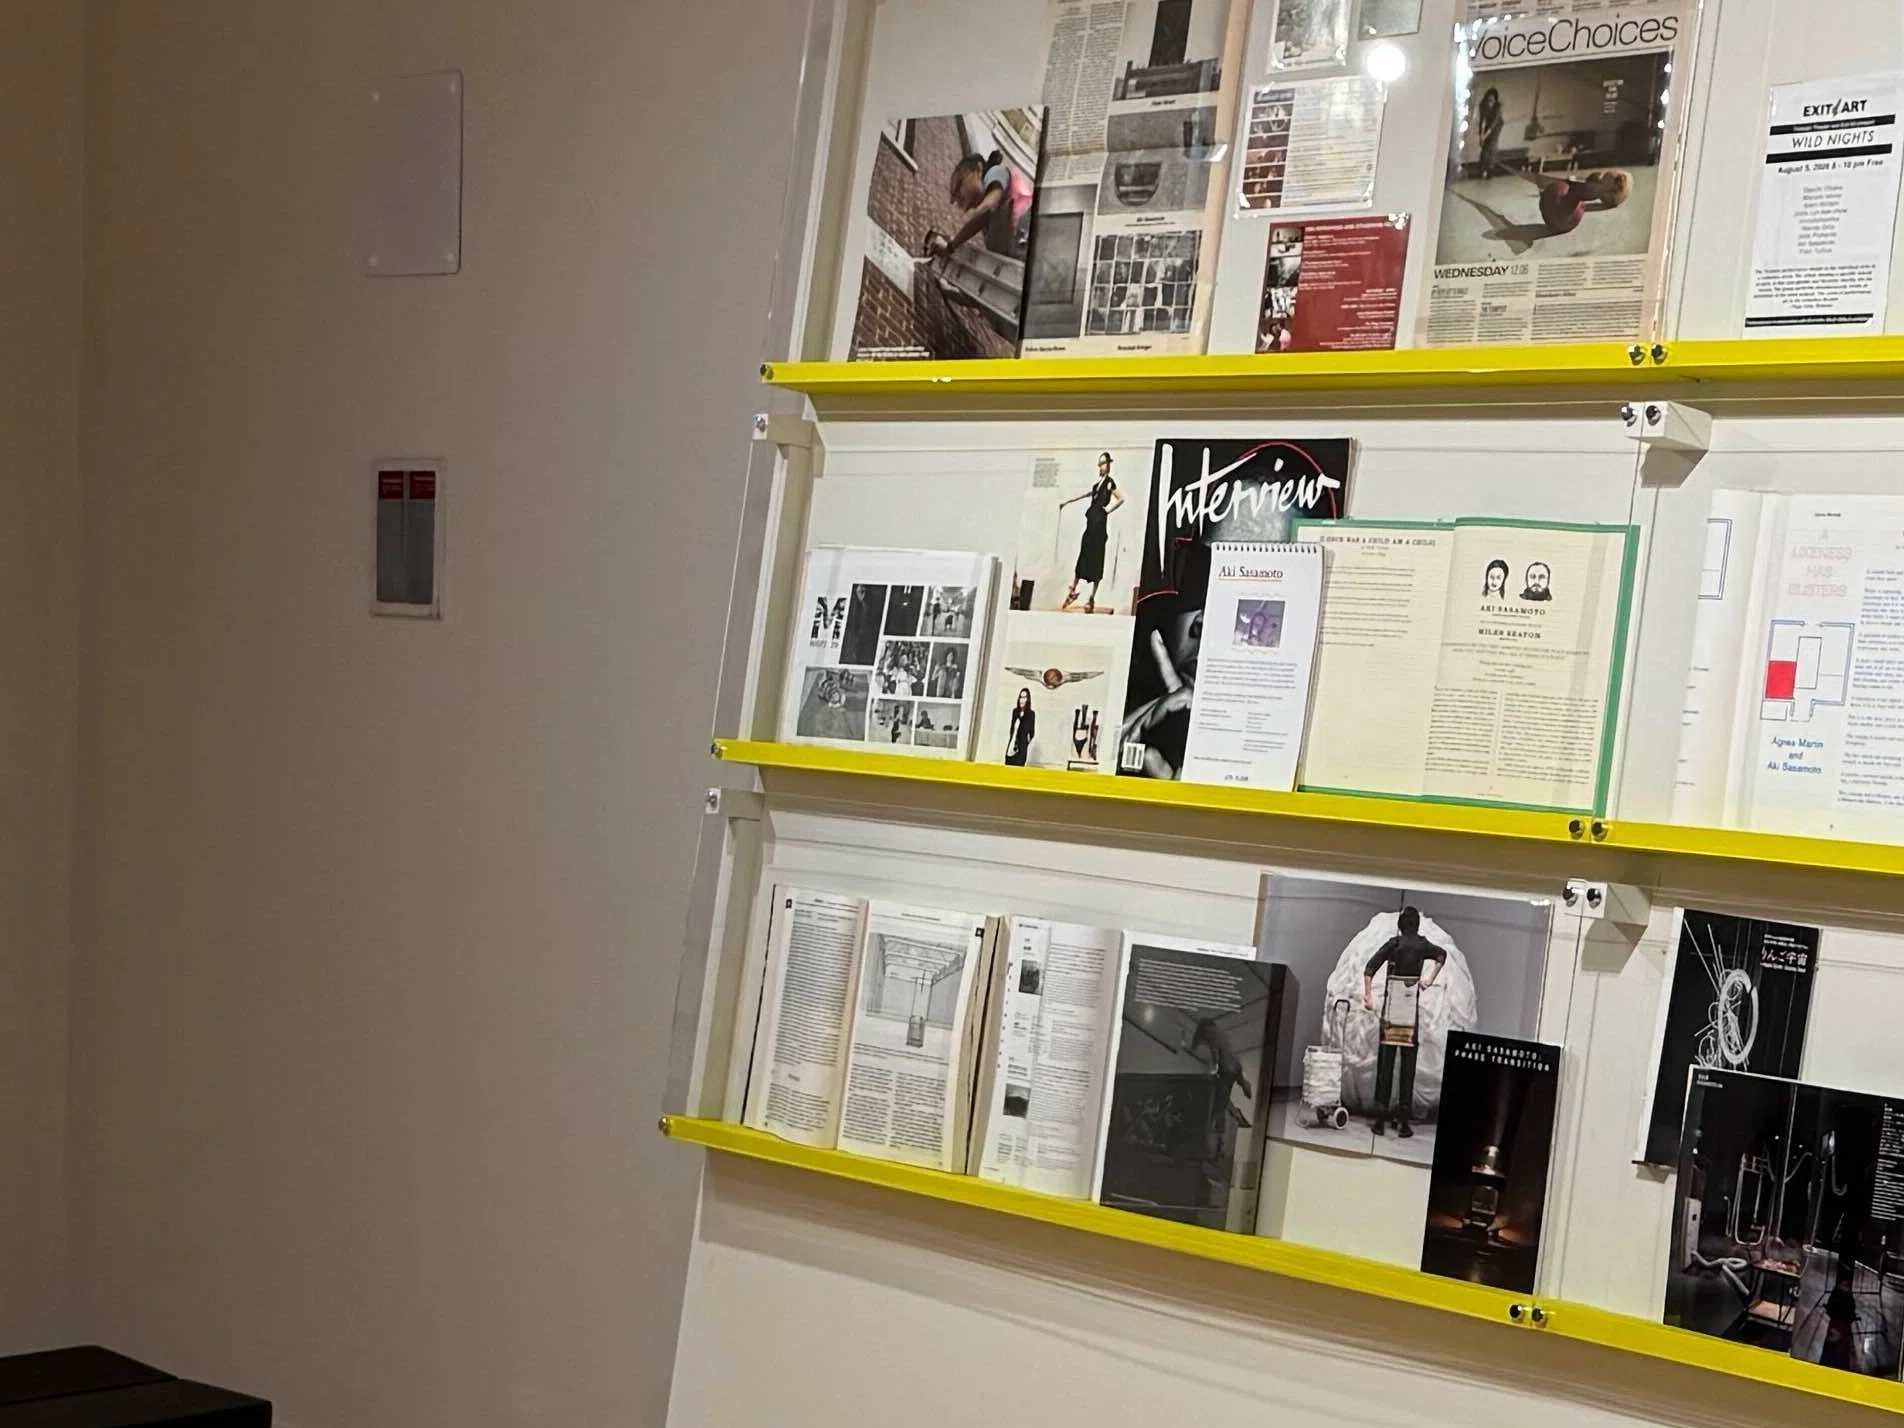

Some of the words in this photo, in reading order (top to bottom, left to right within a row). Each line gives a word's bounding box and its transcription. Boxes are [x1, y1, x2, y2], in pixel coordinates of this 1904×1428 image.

[1792, 135, 1823, 149] WILD
[1827, 130, 1875, 146] NIGHTS
[1778, 166, 1803, 175] August
[1867, 159, 1883, 167] Free
[1434, 265, 1510, 279] WEDNESDAY
[1158, 443, 1341, 580] Interview
[1218, 566, 1236, 578] Aki
[1239, 565, 1284, 579] Sasamoto
[1771, 736, 1796, 748] Agnes
[1491, 1055, 1550, 1072] TRANSITION
